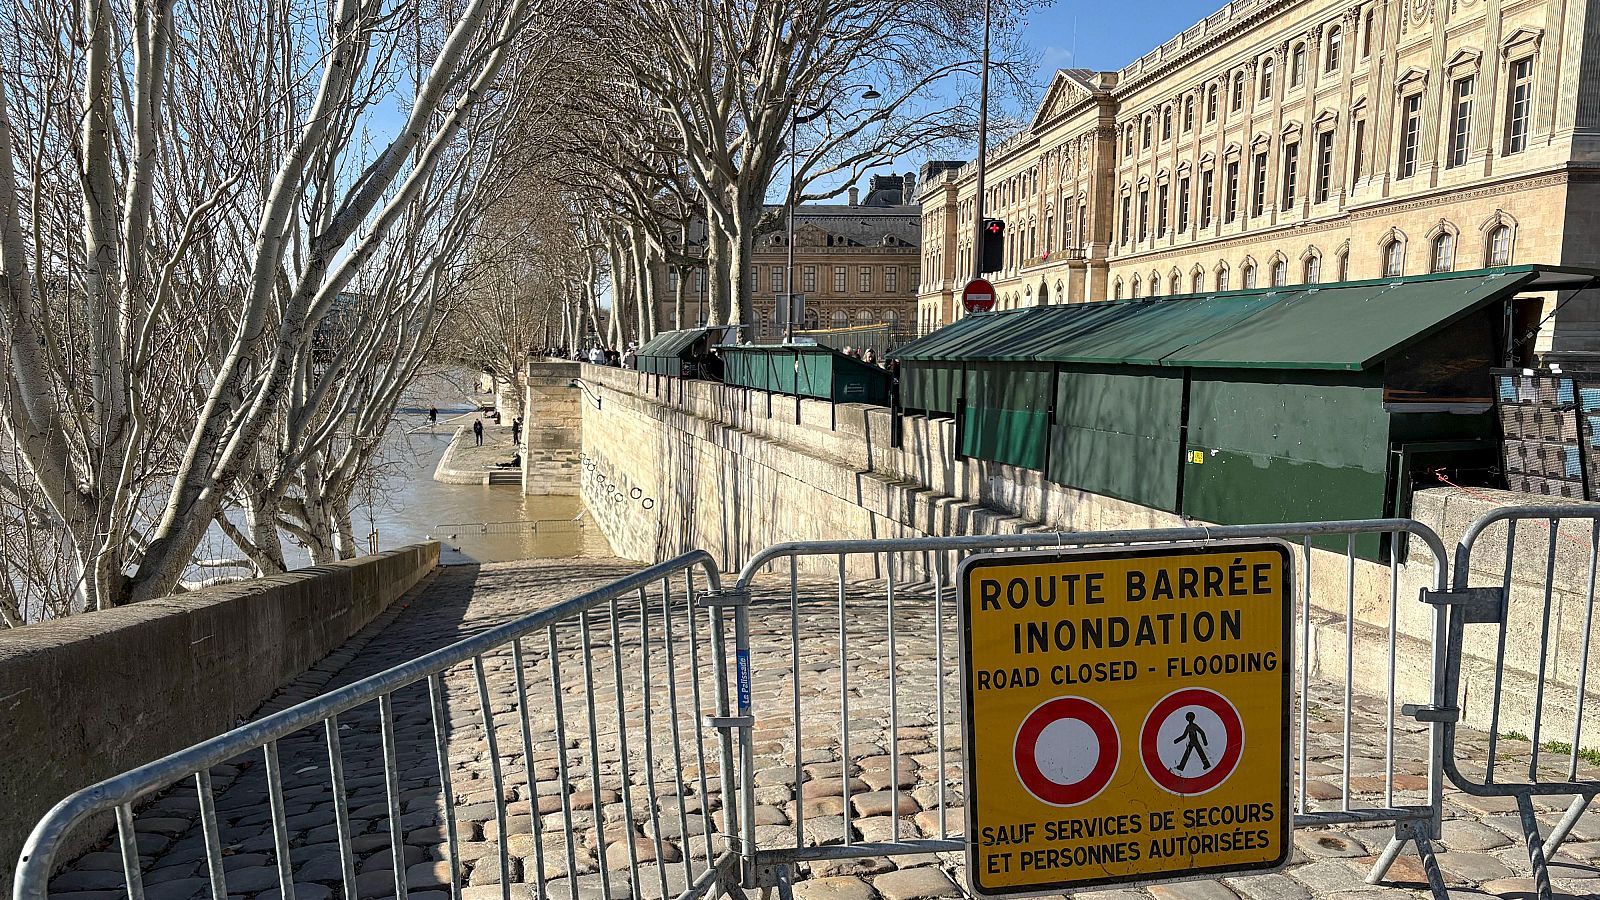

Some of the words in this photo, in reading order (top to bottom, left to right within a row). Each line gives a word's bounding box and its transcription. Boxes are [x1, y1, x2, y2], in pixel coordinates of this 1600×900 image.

[981, 572, 1105, 611] ROUTE
[1126, 558, 1272, 602] BARRÉE
[1014, 609, 1241, 654] INONDATION
[740, 657, 749, 693] Palissade
[978, 667, 1040, 690] ROAD
[1050, 660, 1138, 685] CLOSED
[1167, 651, 1278, 678] FLOODING
[982, 822, 1036, 847] SAUF
[1044, 814, 1142, 842] SERVICES
[1149, 811, 1176, 831] DE
[1183, 802, 1275, 829] SECOURS
[987, 852, 1012, 874] ET
[1020, 842, 1141, 871] PERSONNES
[1149, 829, 1270, 859] AUTORISÉES
